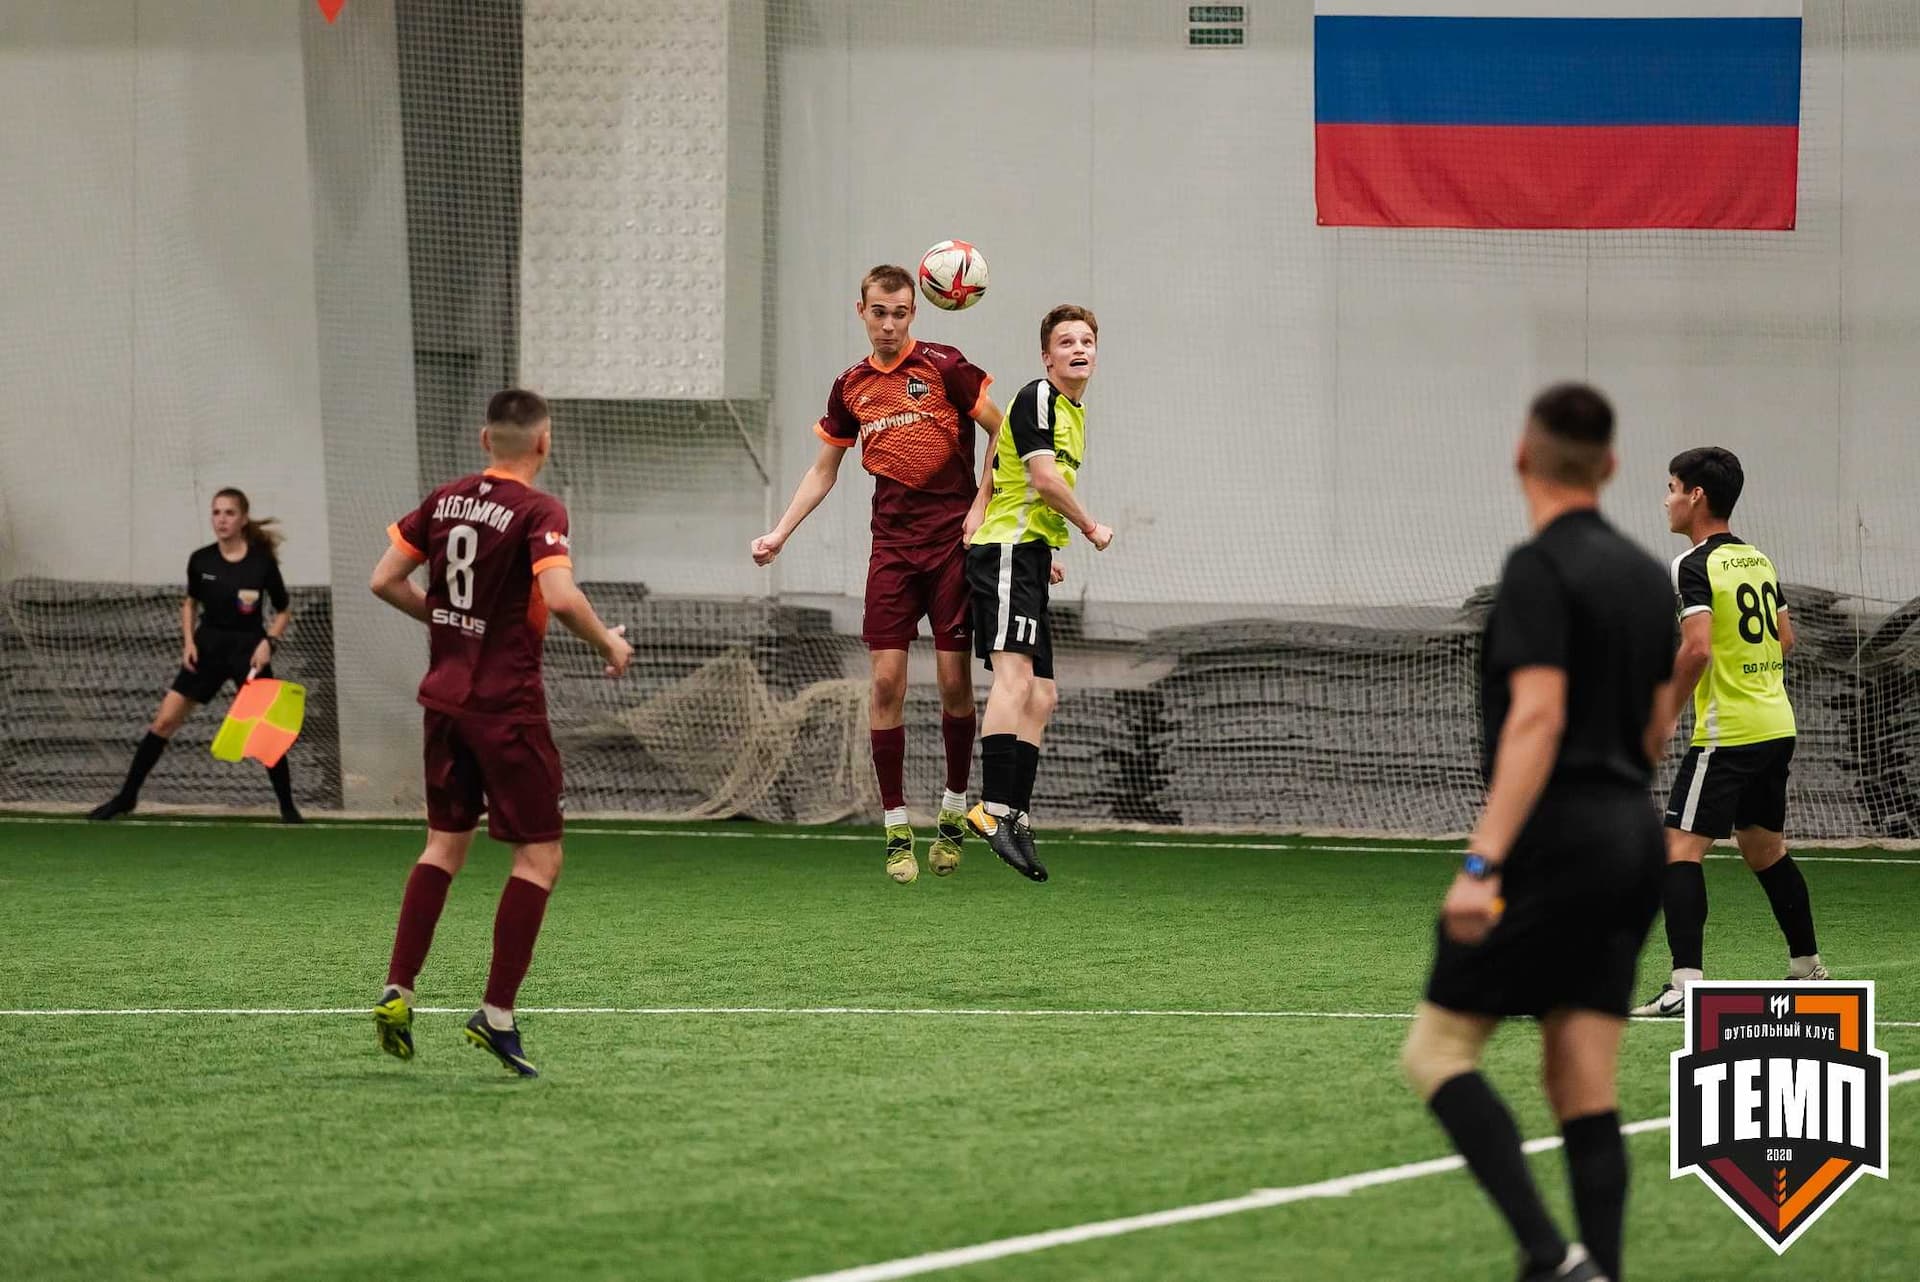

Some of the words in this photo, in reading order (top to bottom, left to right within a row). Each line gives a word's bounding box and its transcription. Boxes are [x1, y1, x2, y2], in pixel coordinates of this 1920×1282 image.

[446, 525, 478, 610] 8
[432, 608, 487, 635] SEUS
[1014, 615, 1037, 645] 11
[1736, 581, 1780, 644] 80
